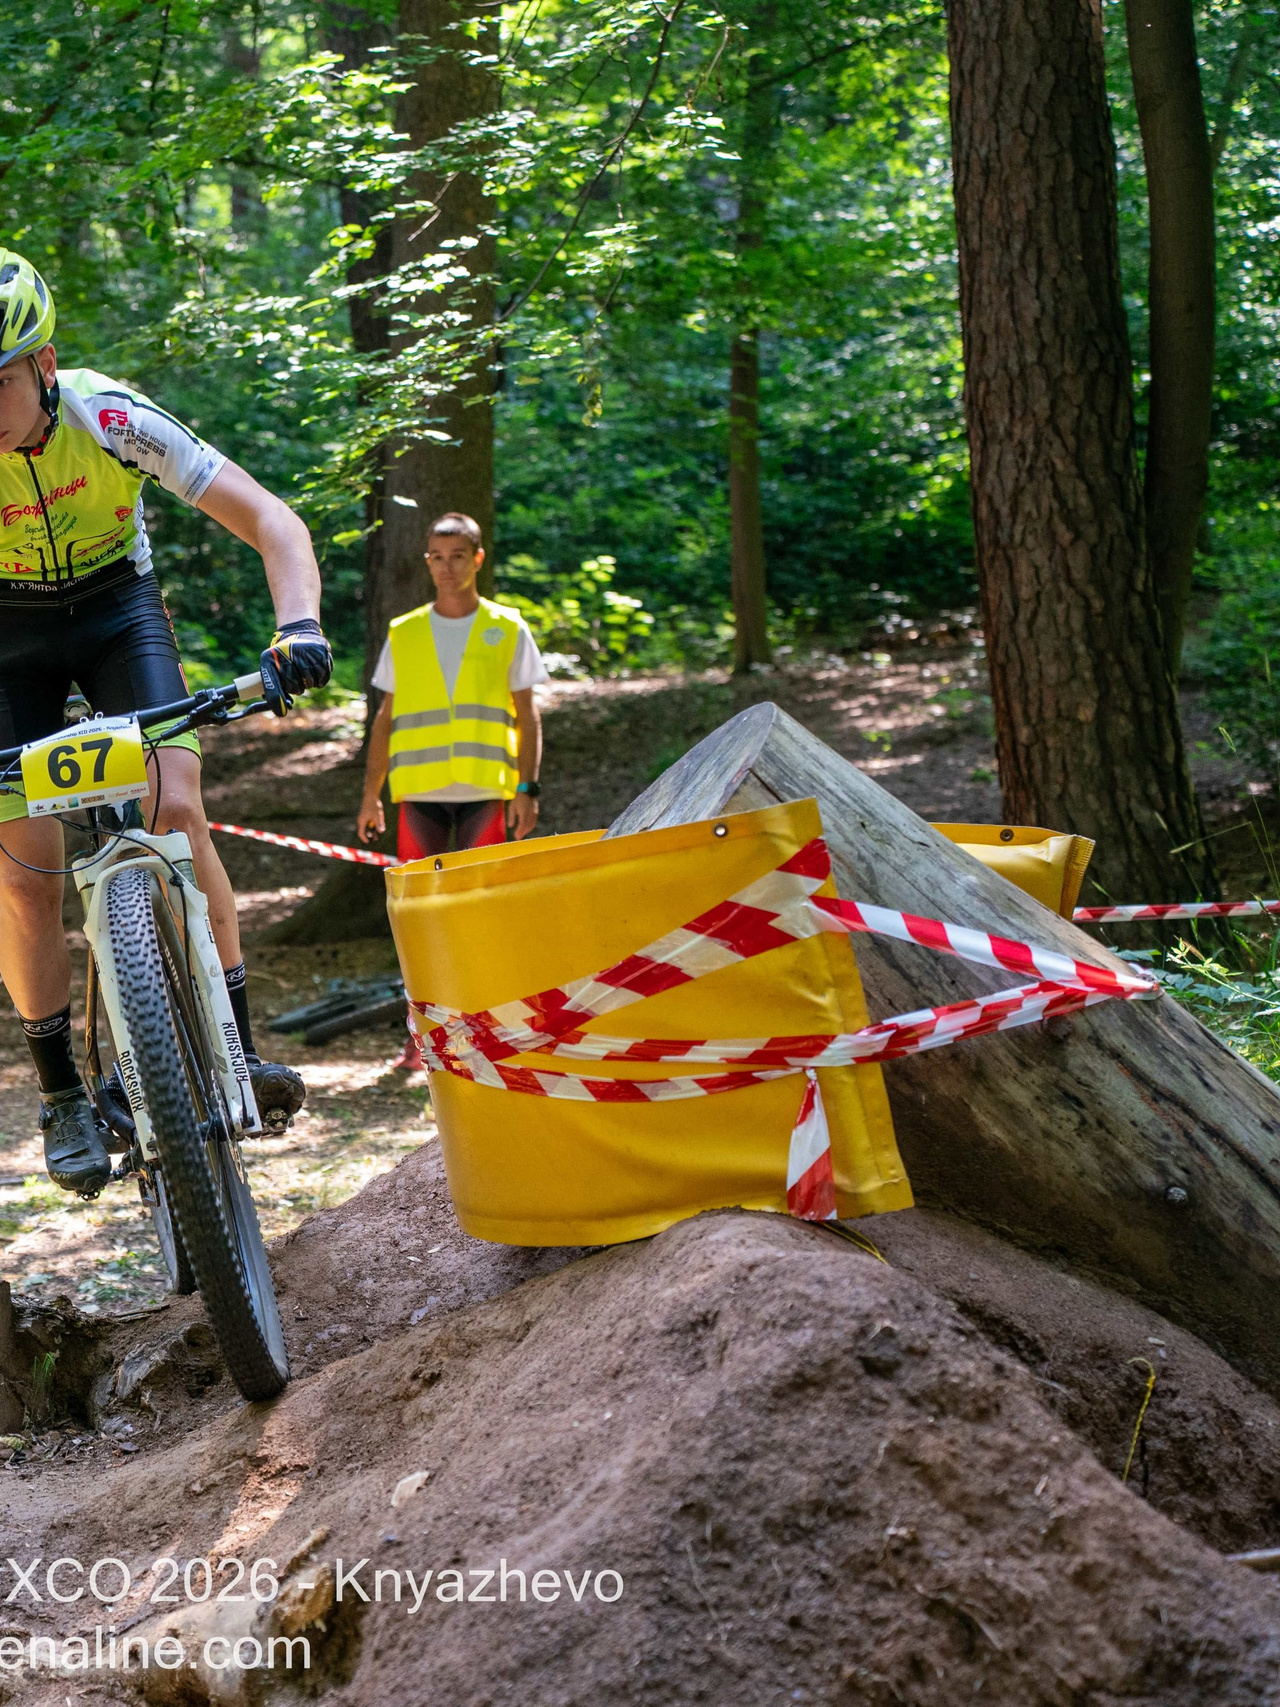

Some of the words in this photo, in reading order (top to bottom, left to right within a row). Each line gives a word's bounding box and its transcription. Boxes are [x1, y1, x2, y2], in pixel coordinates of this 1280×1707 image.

[47, 737, 113, 789] 67
[119, 1050, 144, 1113] ROCKSHOX
[222, 1021, 249, 1082] ROCKSHOX
